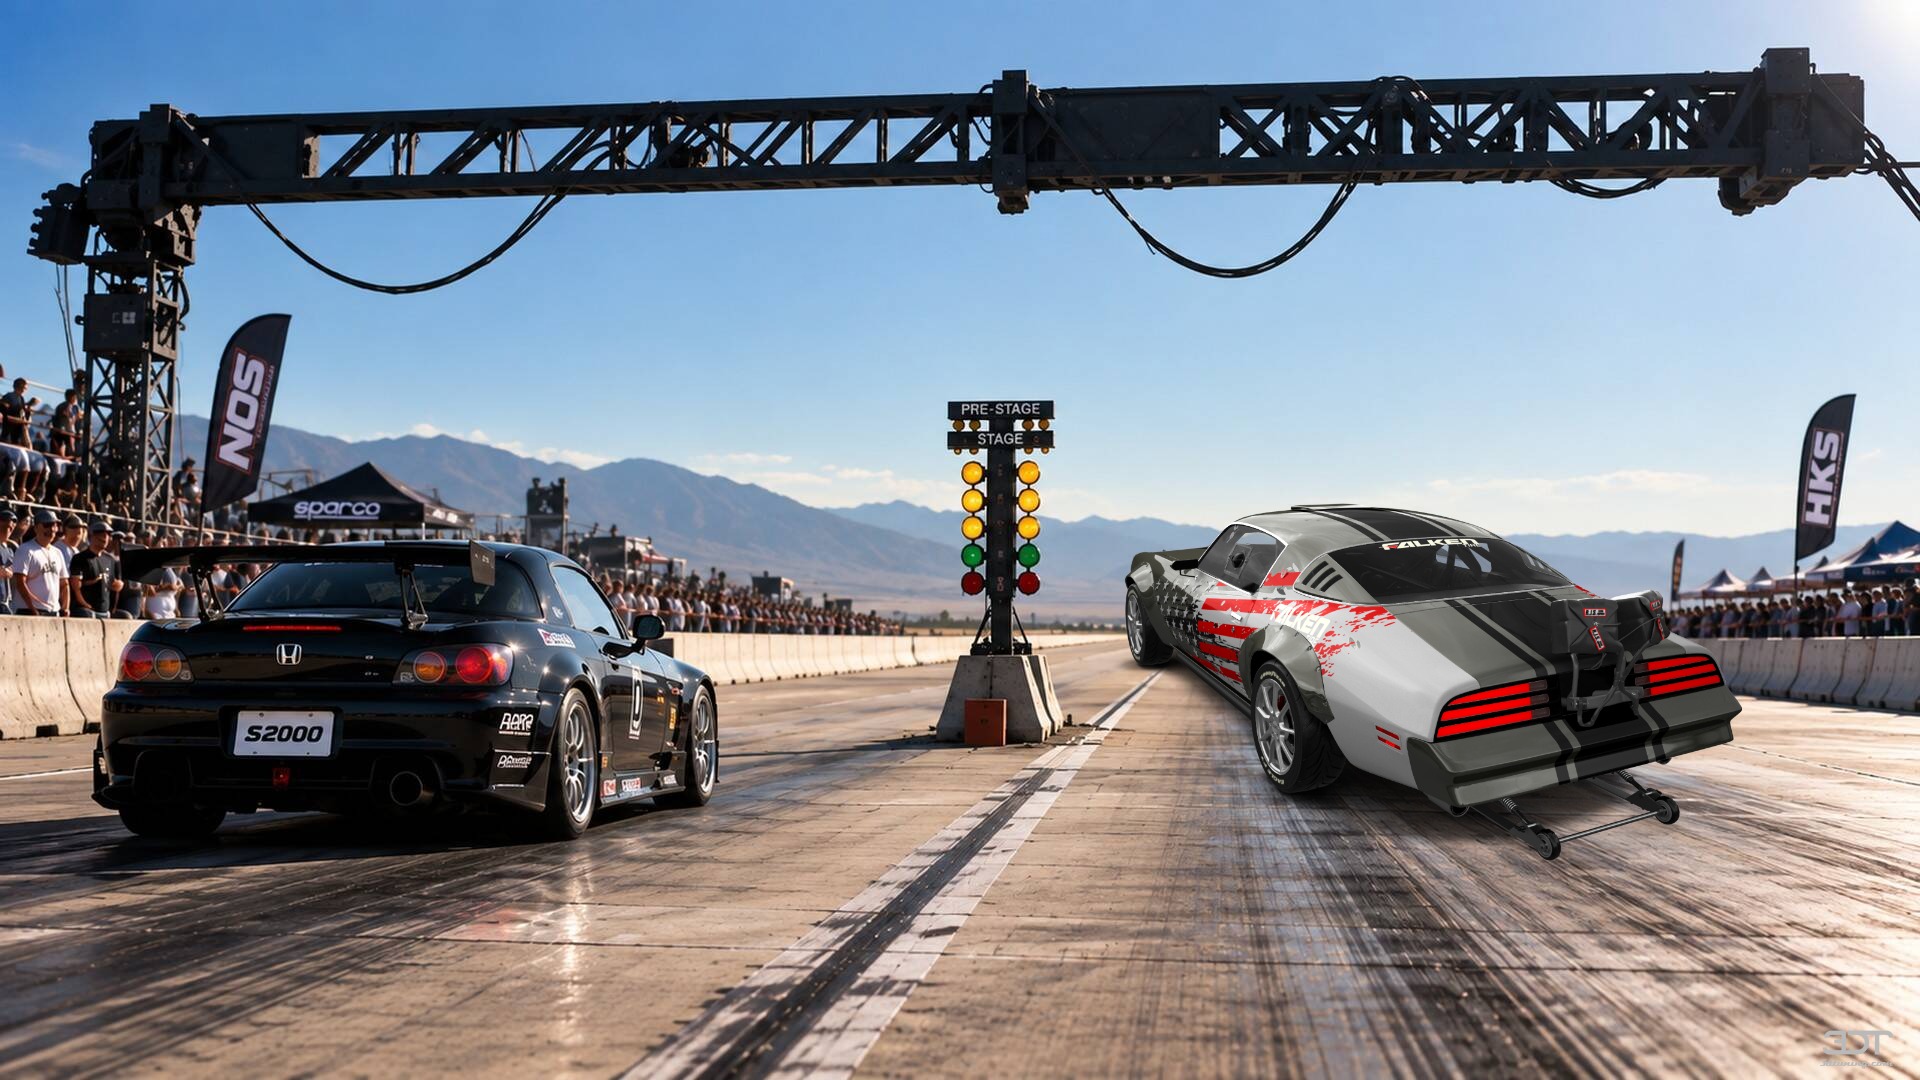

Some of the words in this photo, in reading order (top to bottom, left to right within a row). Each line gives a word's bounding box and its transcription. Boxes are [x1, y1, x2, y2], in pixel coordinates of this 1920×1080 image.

[219, 353, 265, 470] NOS
[961, 403, 1040, 415] PRE-STAGE
[978, 433, 1023, 444] STAGE
[1805, 431, 1840, 524] HKS
[294, 501, 381, 520] sparco
[1381, 539, 1479, 550] FALKEN
[1270, 604, 1330, 639] FALKEN
[244, 725, 324, 742] S2000
